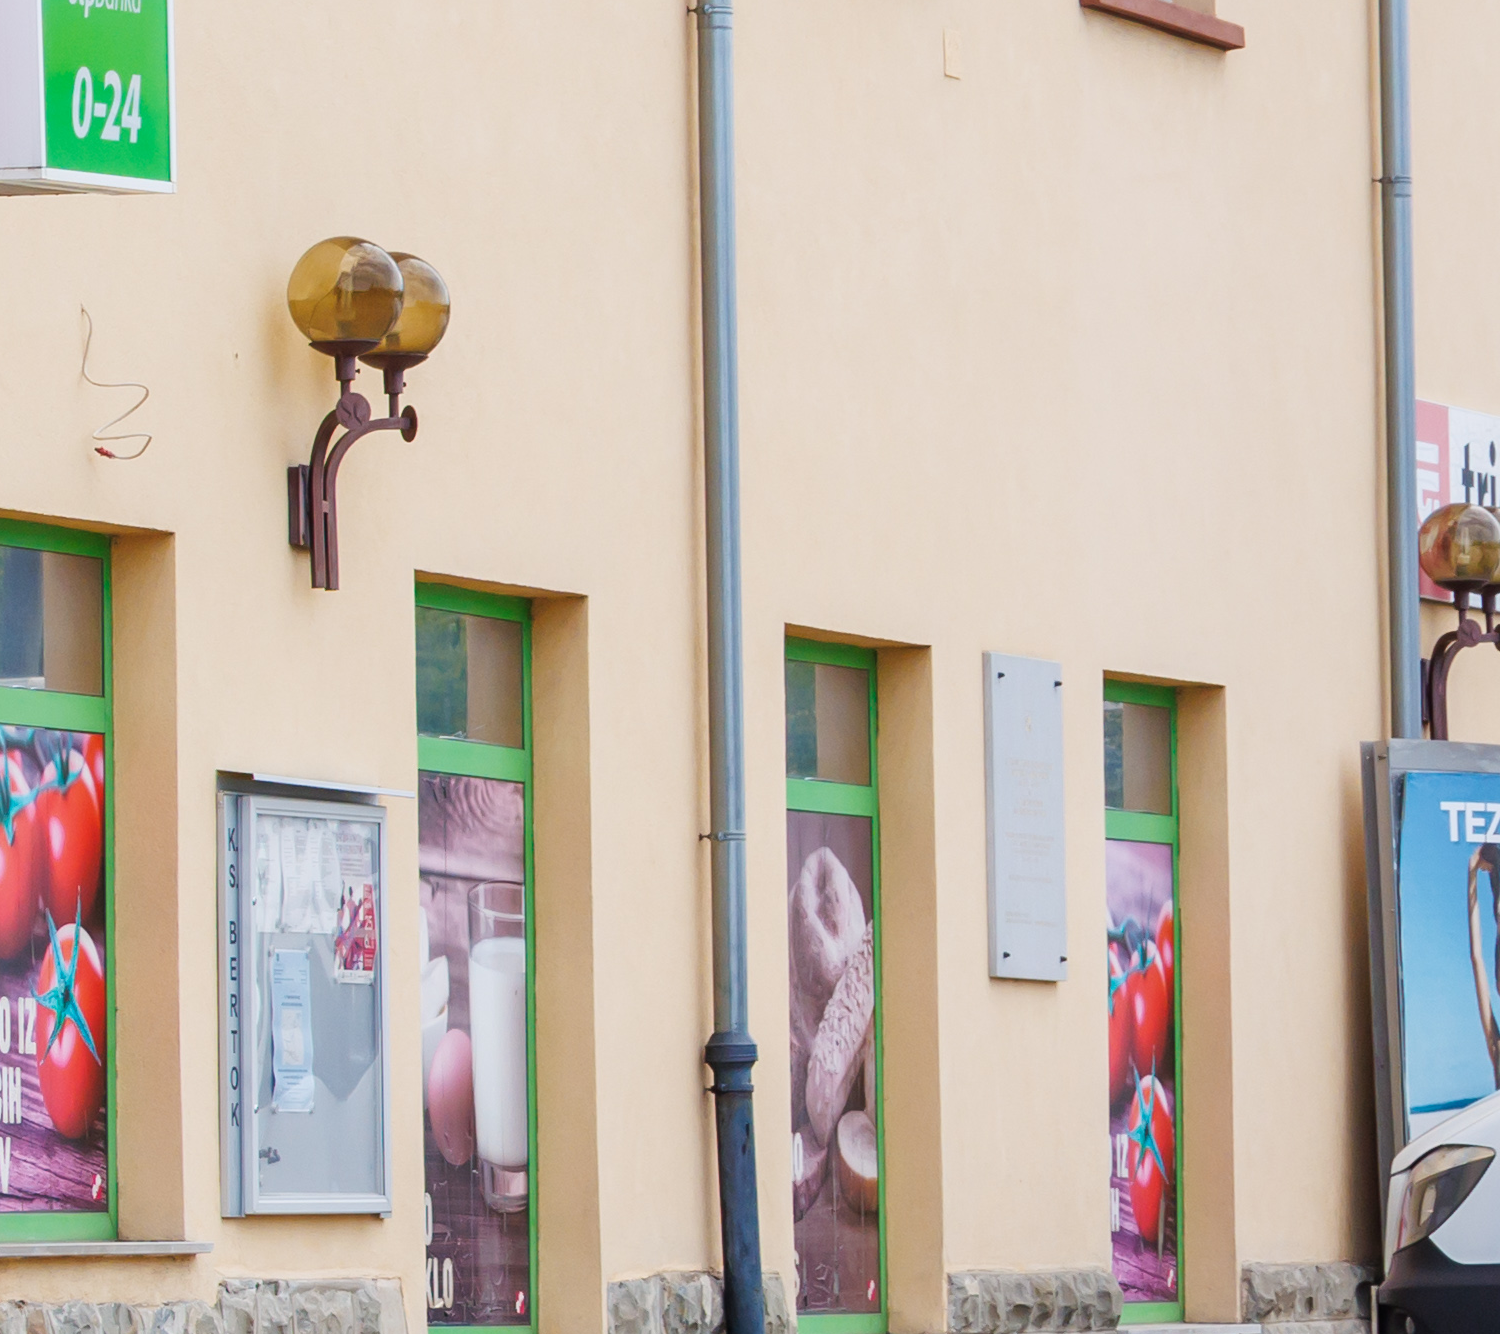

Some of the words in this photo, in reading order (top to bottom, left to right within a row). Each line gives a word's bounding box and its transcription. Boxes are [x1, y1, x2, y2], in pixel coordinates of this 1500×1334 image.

[71, 66, 143, 144] 0-24
[1439, 800, 1500, 844] TEZ
[17, 996, 37, 1056] IZ
[228, 920, 240, 1127] BERTOK
[1116, 1132, 1129, 1179] IZ
